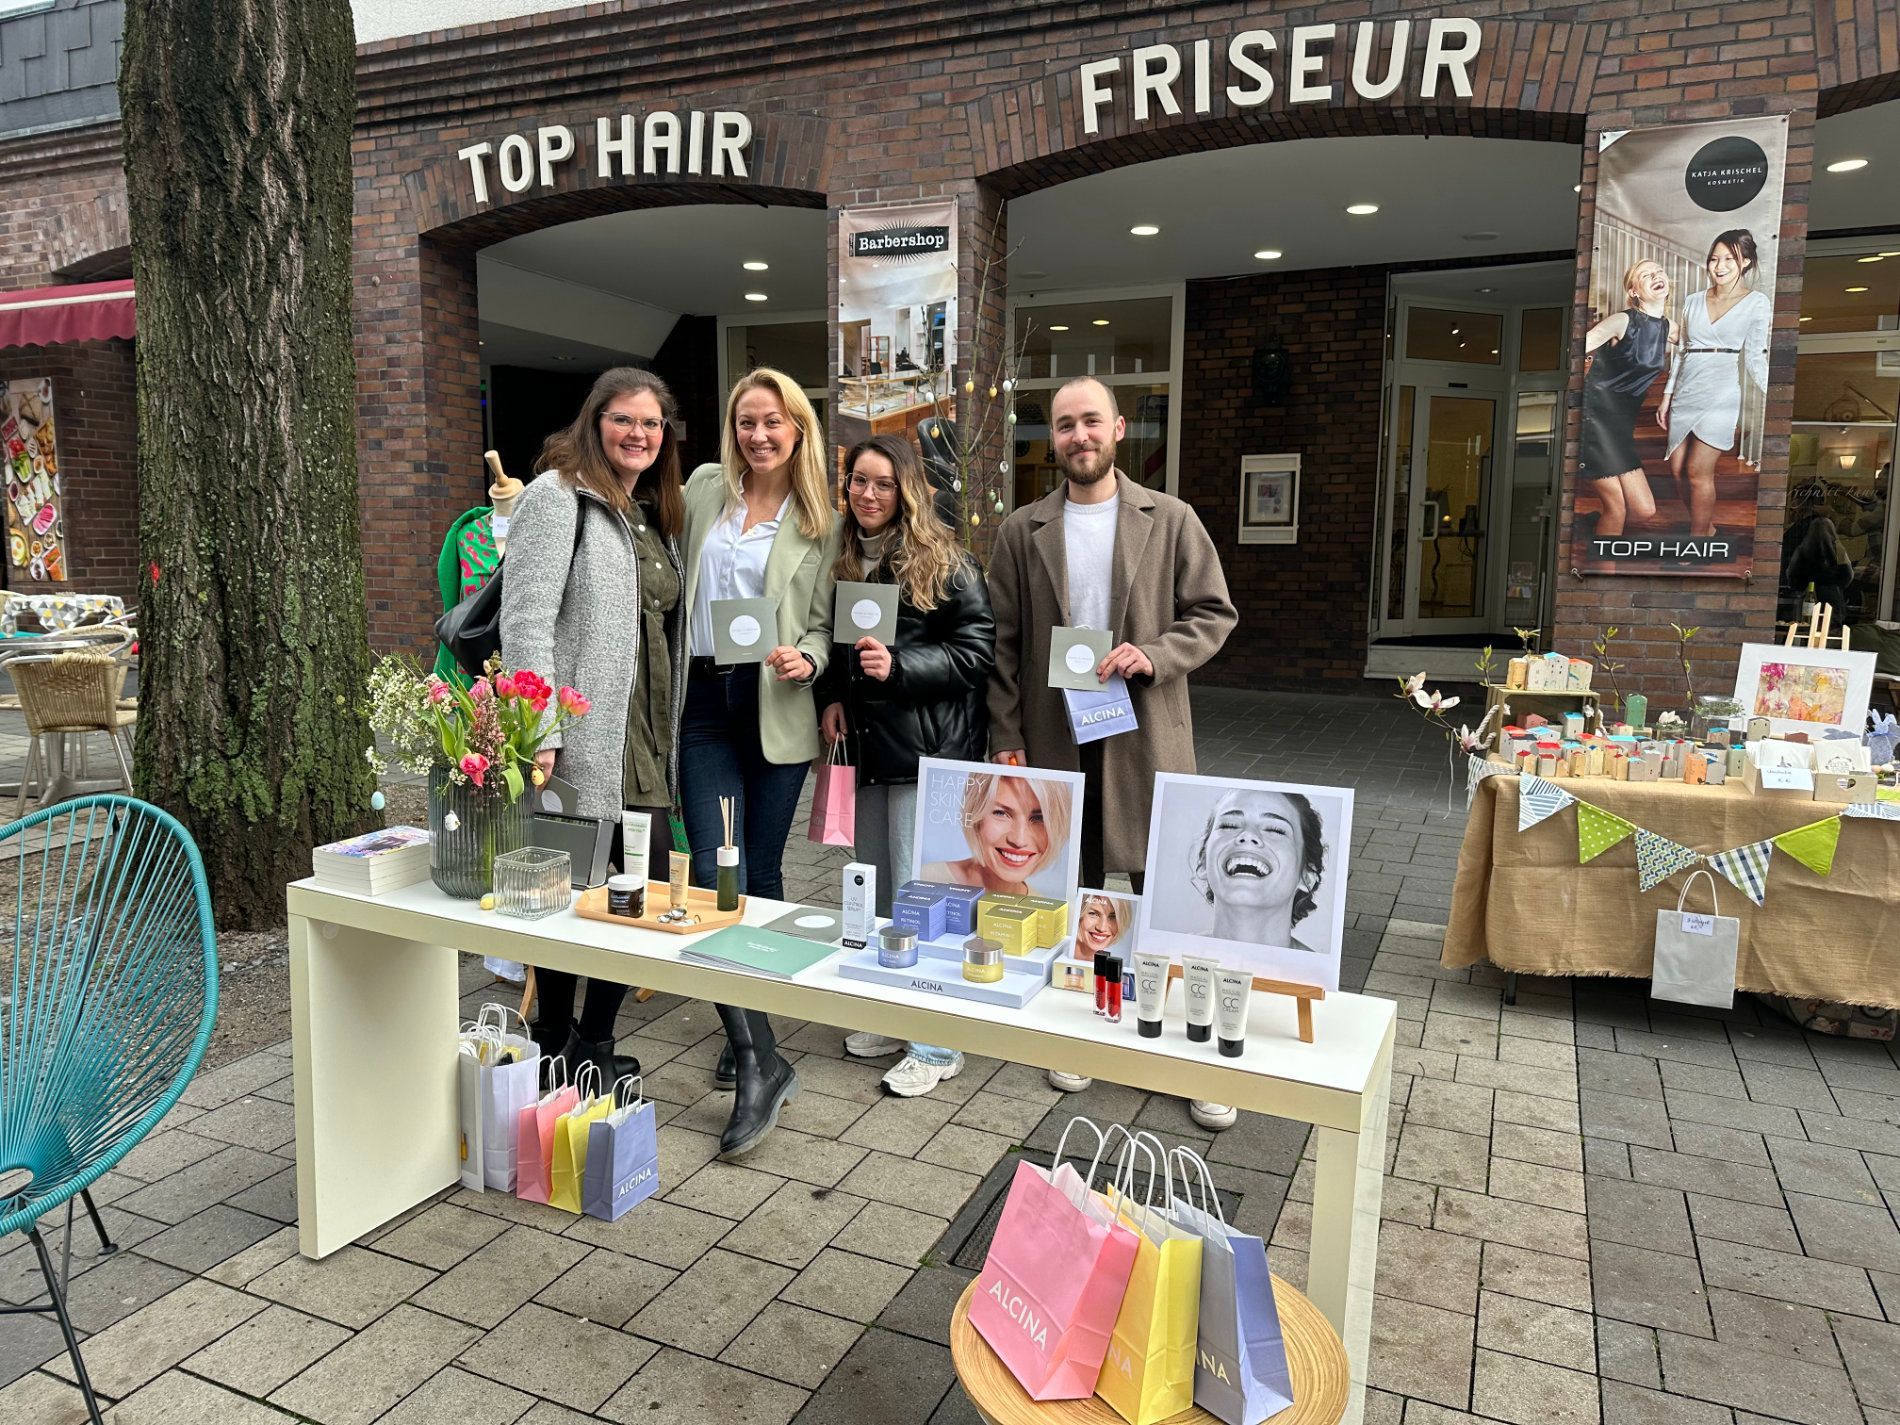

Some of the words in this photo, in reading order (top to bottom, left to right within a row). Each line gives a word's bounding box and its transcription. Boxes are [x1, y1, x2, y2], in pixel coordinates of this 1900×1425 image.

[1080, 18, 1482, 135] FRISEUR
[458, 125, 575, 203] TOP
[597, 111, 752, 178] HAIR
[1691, 170, 1717, 178] KATJA
[1720, 167, 1762, 176] KRISCHEL
[1707, 178, 1745, 186] KOSMETIK
[858, 233, 945, 251] Barbershop
[1593, 540, 1652, 556] TOP
[1659, 541, 1729, 558] HAIR
[1081, 706, 1126, 726] ALCINA
[931, 772, 986, 793] HAPPY
[930, 791, 966, 809] SKIN
[928, 808, 974, 829] CARE
[844, 939, 863, 948] ALCINA
[1142, 960, 1160, 968] ALCINA
[910, 980, 944, 992] ALCINA
[1141, 979, 1157, 991] CC
[1190, 983, 1207, 996] CC
[1222, 977, 1242, 985] ALCINA
[1222, 996, 1240, 1009] CC
[617, 1167, 652, 1199] ALCINA
[989, 1279, 1048, 1351] ALCINA
[1196, 1347, 1231, 1386] INA
